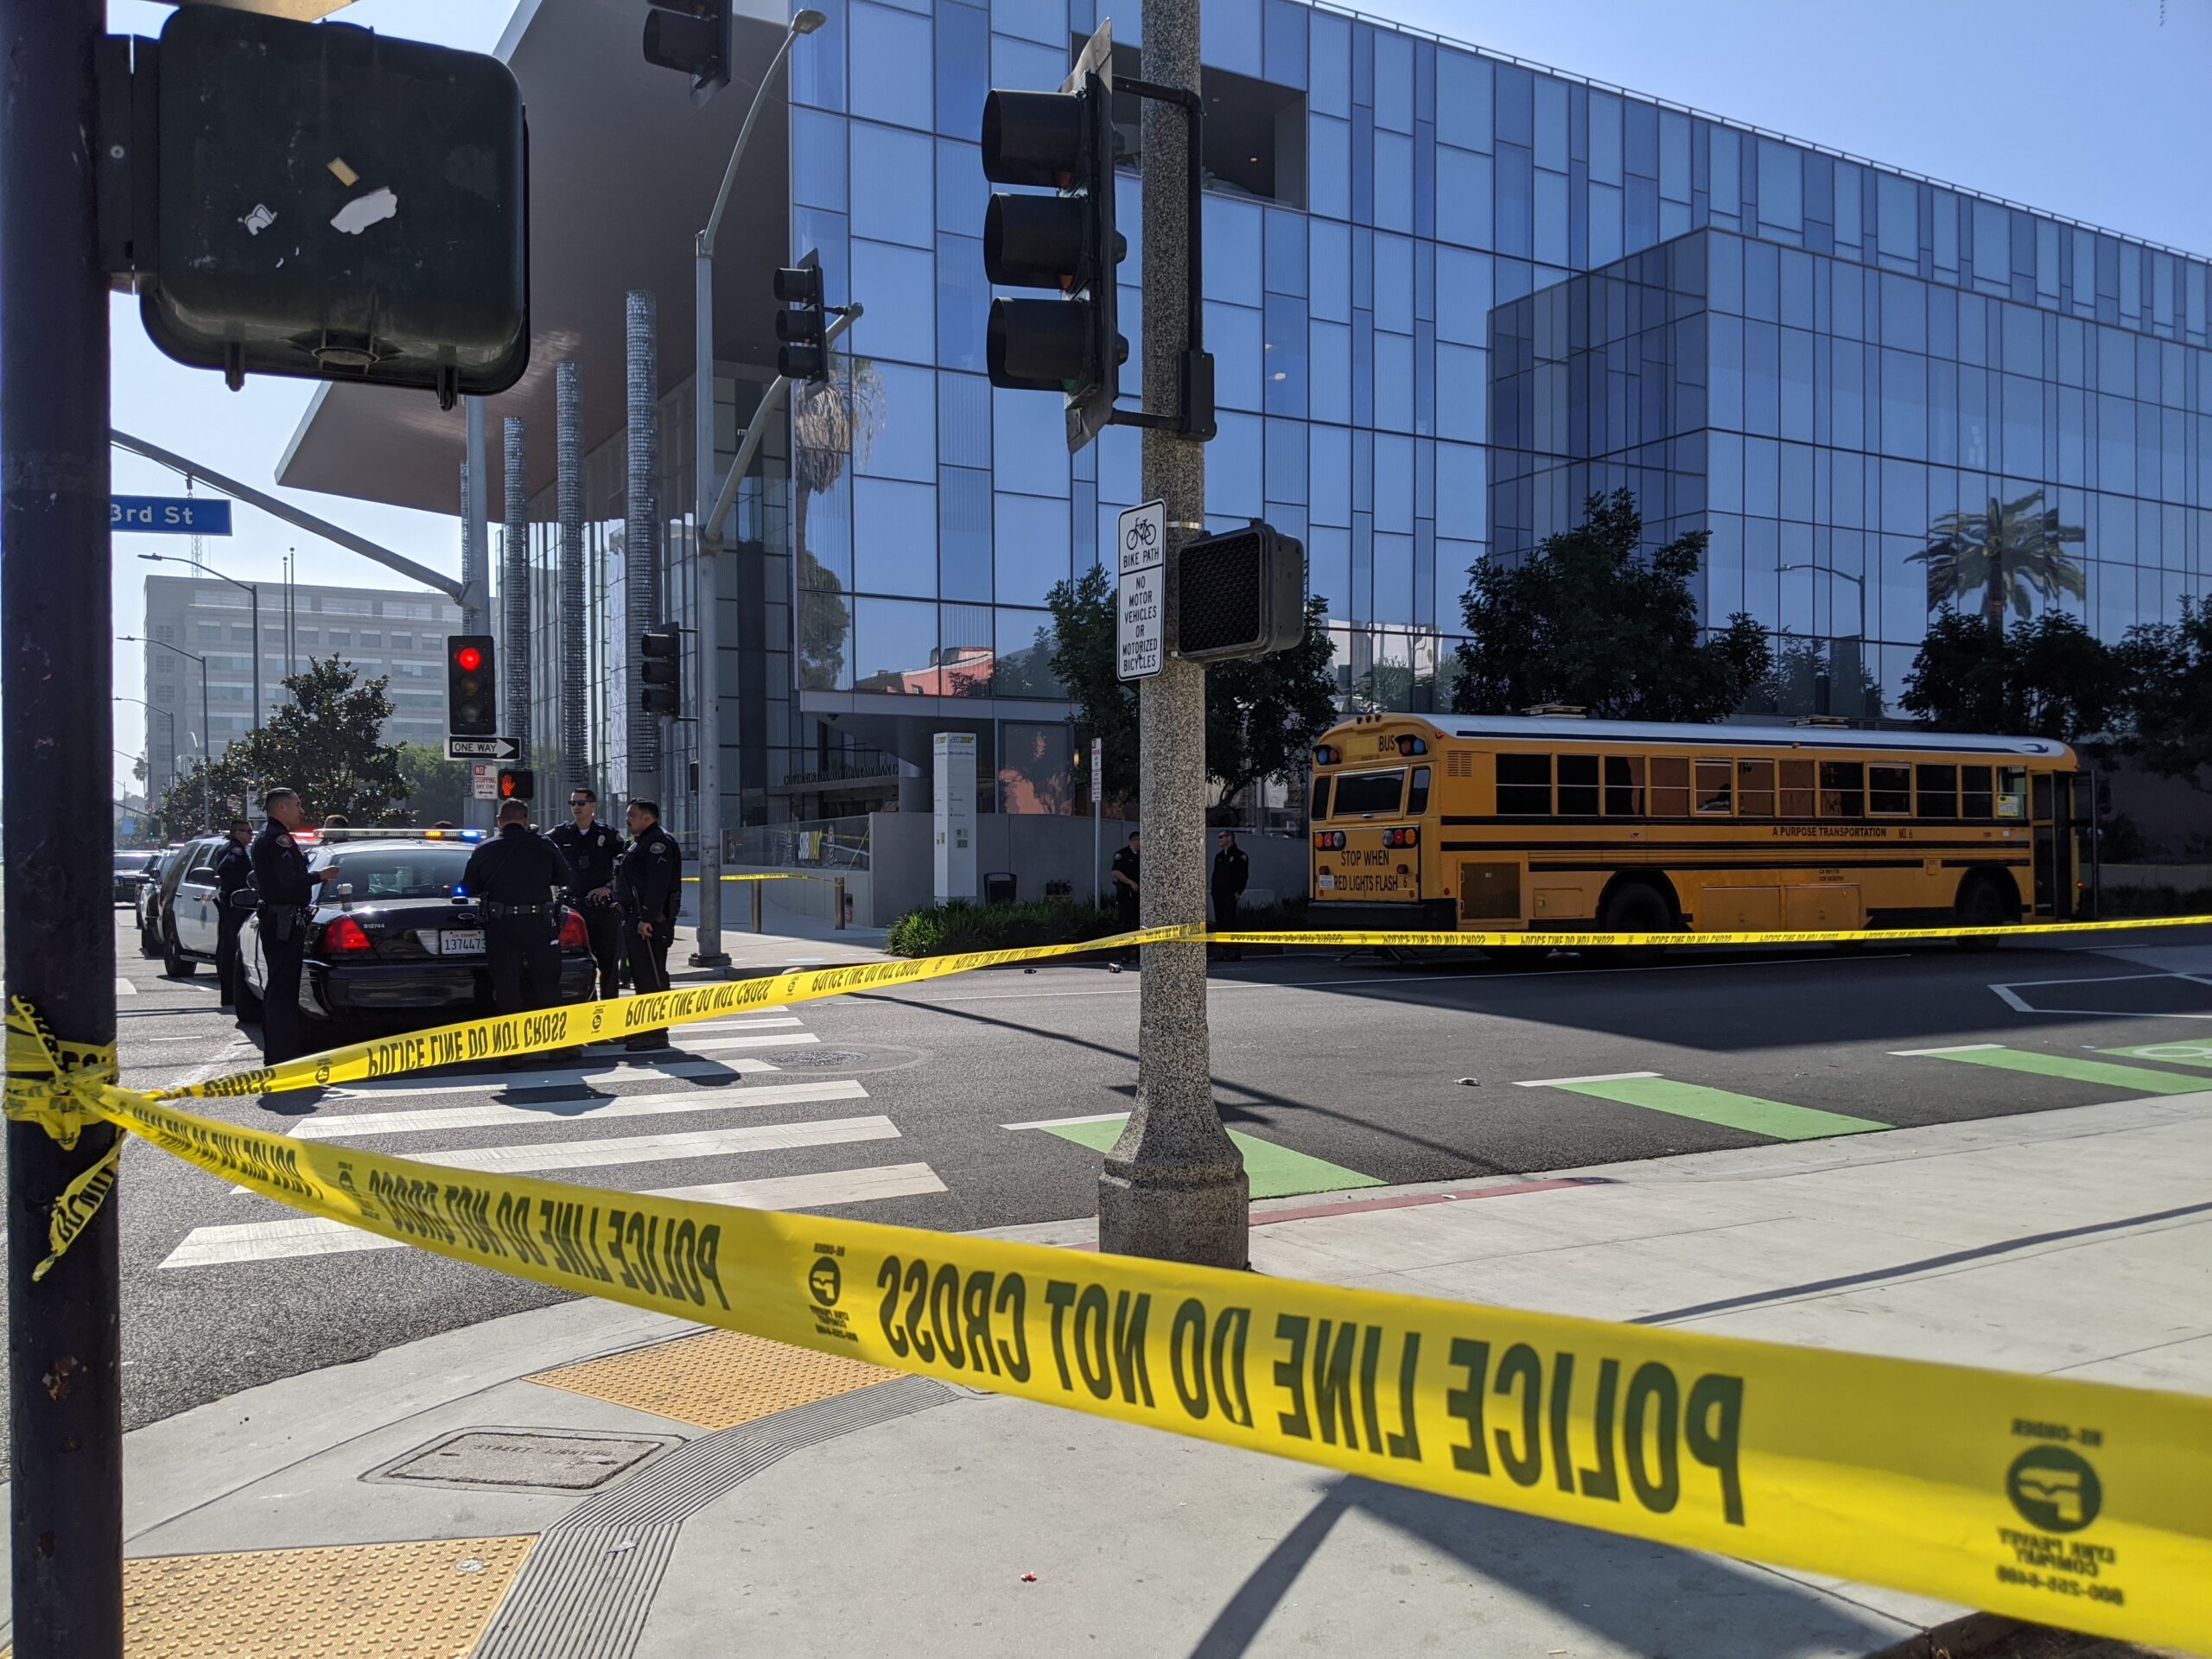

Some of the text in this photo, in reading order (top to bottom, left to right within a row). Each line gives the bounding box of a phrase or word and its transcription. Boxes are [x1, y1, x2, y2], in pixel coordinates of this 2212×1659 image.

[111, 504, 194, 524] 3rd St
[1123, 547, 1160, 568] BIKE PATH
[1135, 575, 1146, 590] NO
[1128, 590, 1153, 607] MOTOR
[1124, 606, 1157, 625] VEHICLES
[1135, 625, 1145, 638] OR
[1122, 638, 1158, 657] MOTORIZED
[1123, 655, 1156, 672] BICYCLES
[454, 743, 474, 752] ONE
[1378, 735, 1395, 752] BUS
[475, 766, 485, 775] NO
[1772, 827, 1778, 837] A
[1780, 827, 1817, 837] PURPOSE
[1819, 827, 1887, 837] TRANSPORTATION
[1340, 849, 1389, 866] STOP WHEN
[1334, 875, 1348, 891] RED
[1350, 875, 1375, 892] LIGHTS
[1376, 874, 1398, 891] FLASH
[1402, 876, 1408, 888] 6
[474, 1445, 613, 1457] STREET LIGHTING
